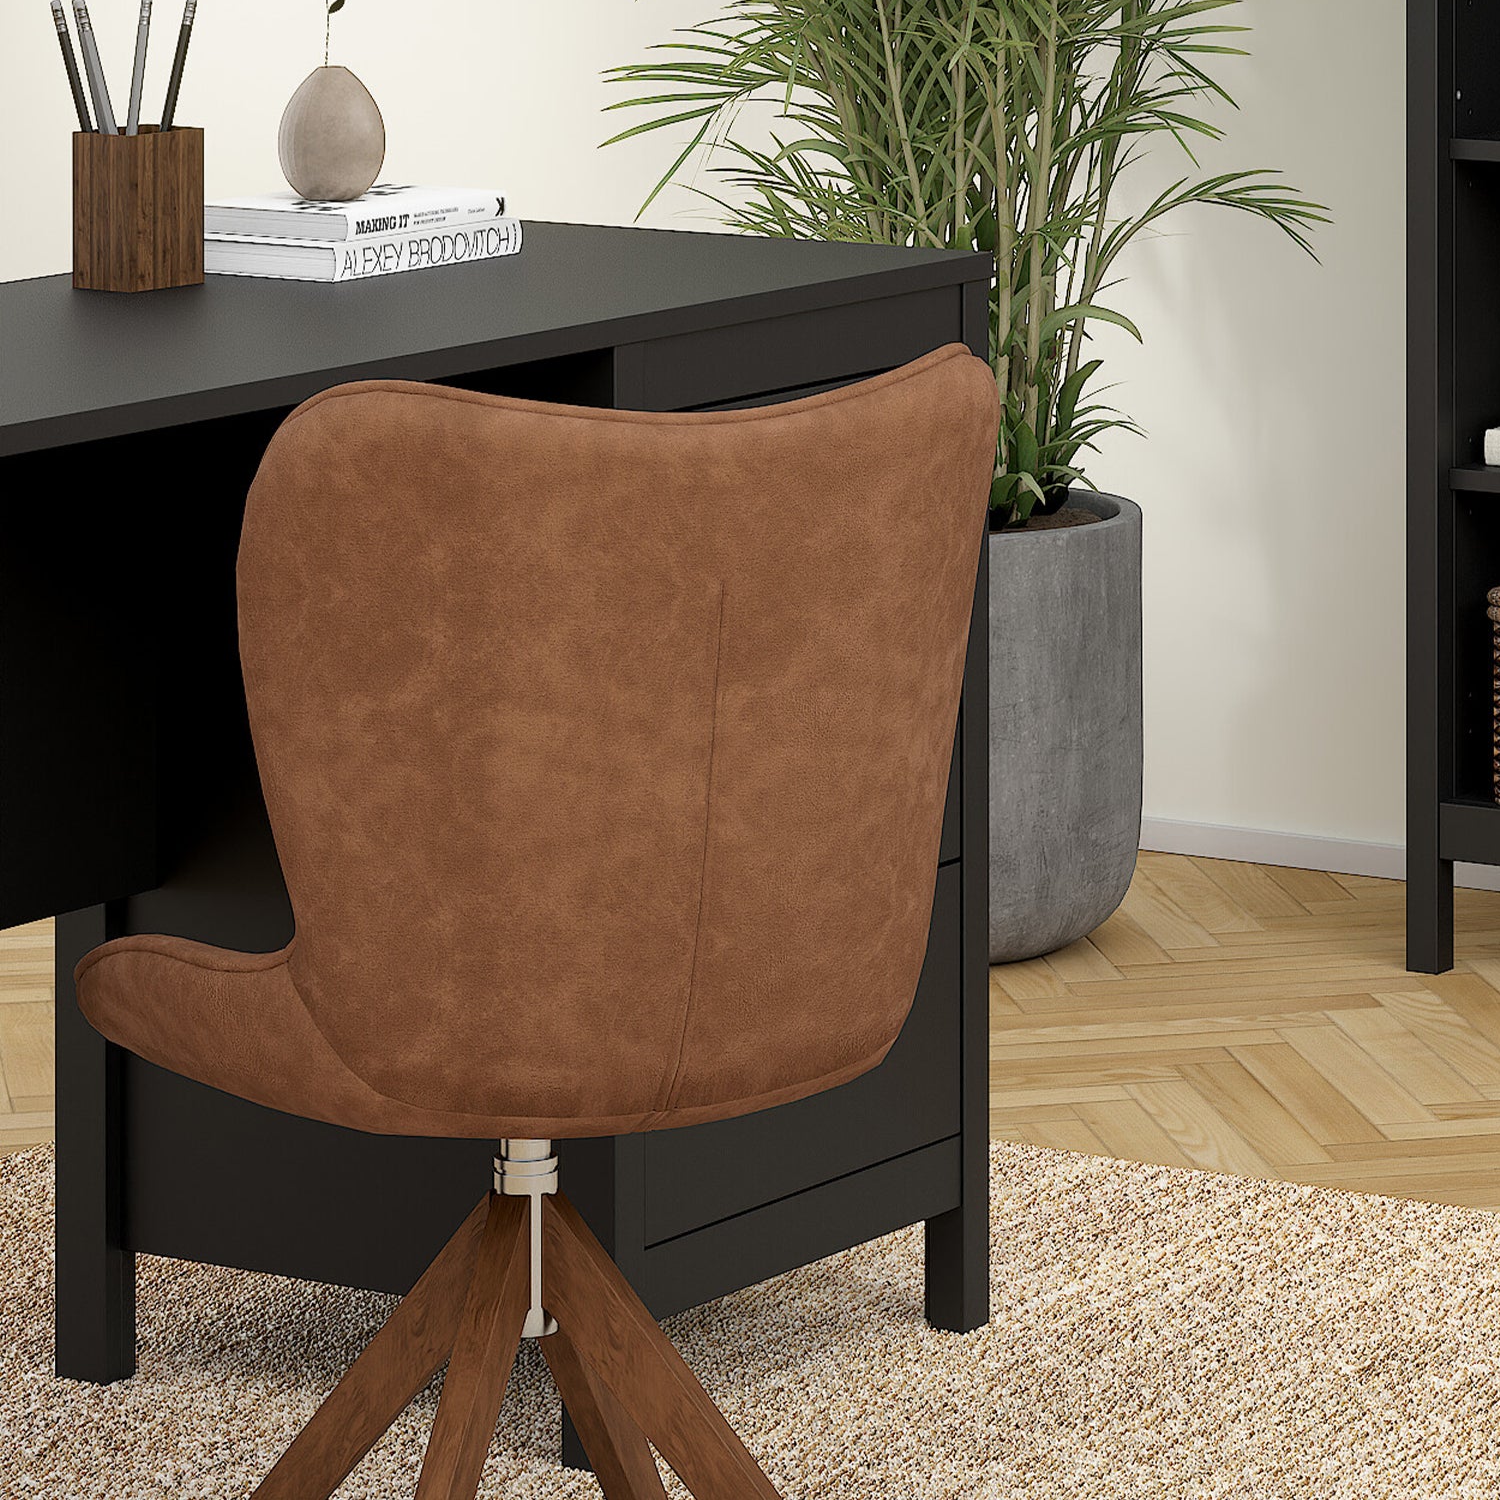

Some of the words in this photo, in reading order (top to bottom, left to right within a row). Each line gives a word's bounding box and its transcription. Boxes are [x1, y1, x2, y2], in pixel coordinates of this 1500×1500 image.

[355, 215, 397, 235] MAKING
[399, 214, 410, 229] IT
[340, 242, 403, 279] ALEXEY
[408, 225, 510, 268] BRODOVITCH
